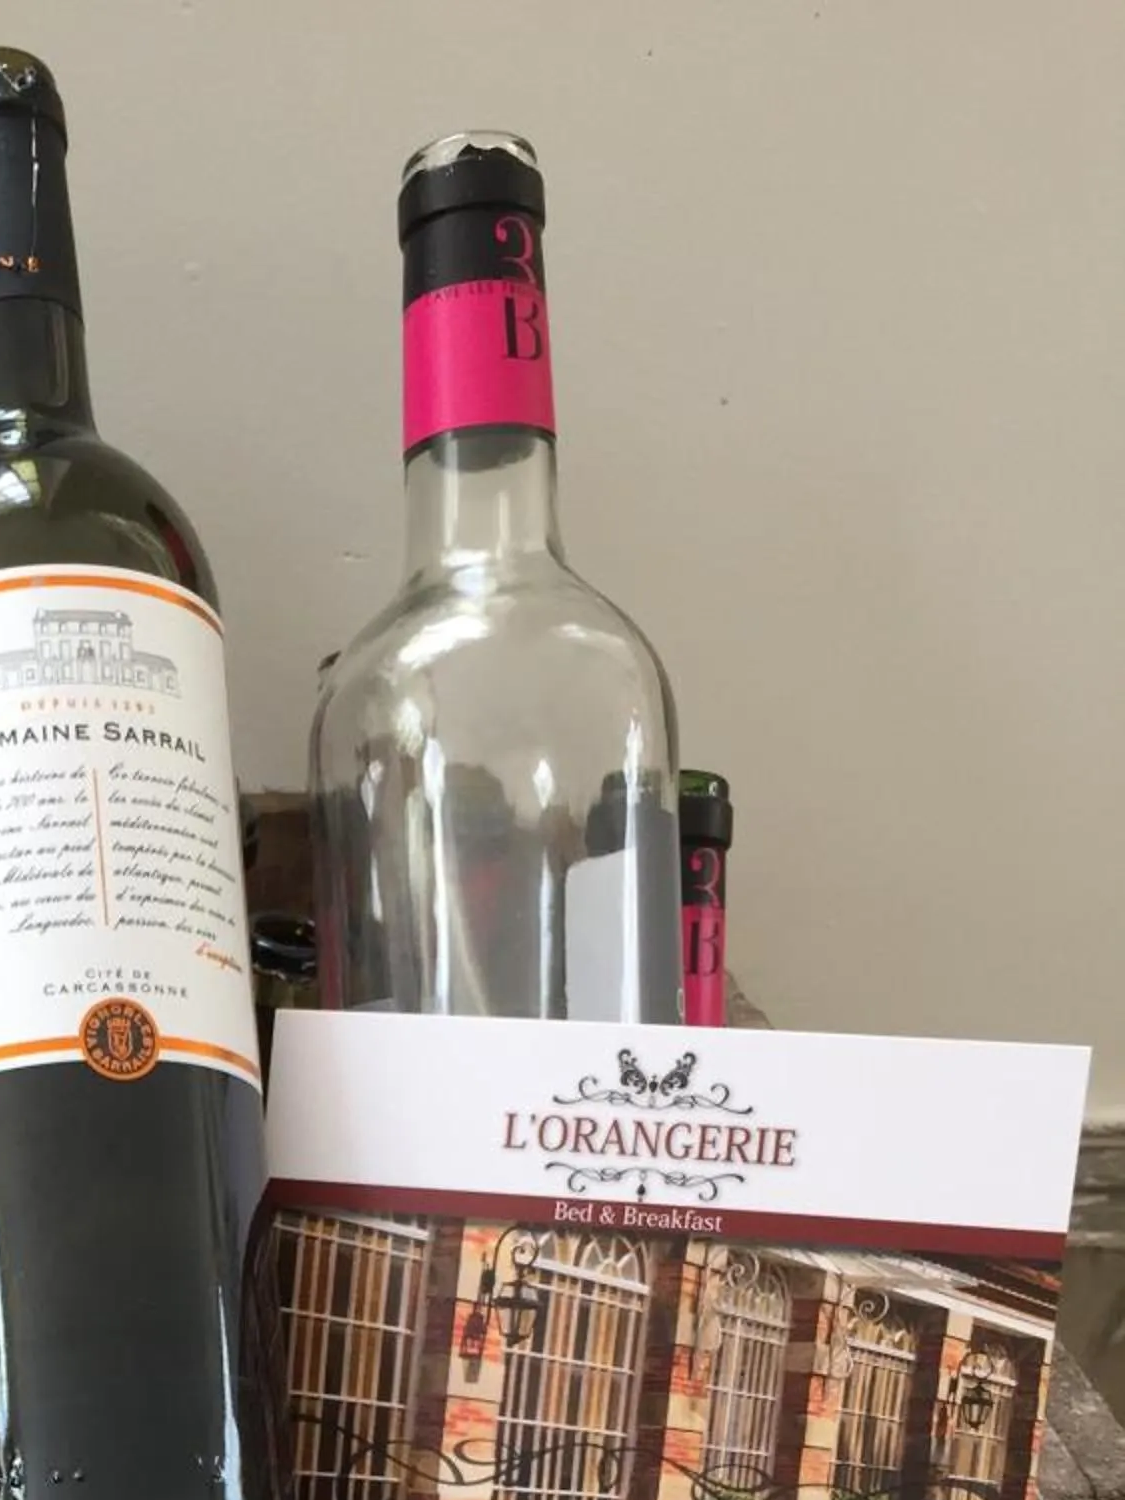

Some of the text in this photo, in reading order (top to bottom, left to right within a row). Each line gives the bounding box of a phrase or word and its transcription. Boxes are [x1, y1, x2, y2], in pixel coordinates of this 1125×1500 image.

[501, 296, 543, 361] B
[102, 720, 207, 763] SARRAIL
[43, 980, 190, 999] CARCASSONNE
[84, 965, 152, 981] CITÉ DE
[503, 1112, 798, 1168] L'ORANGERIE
[554, 1201, 724, 1234] Bed & Breakfast
